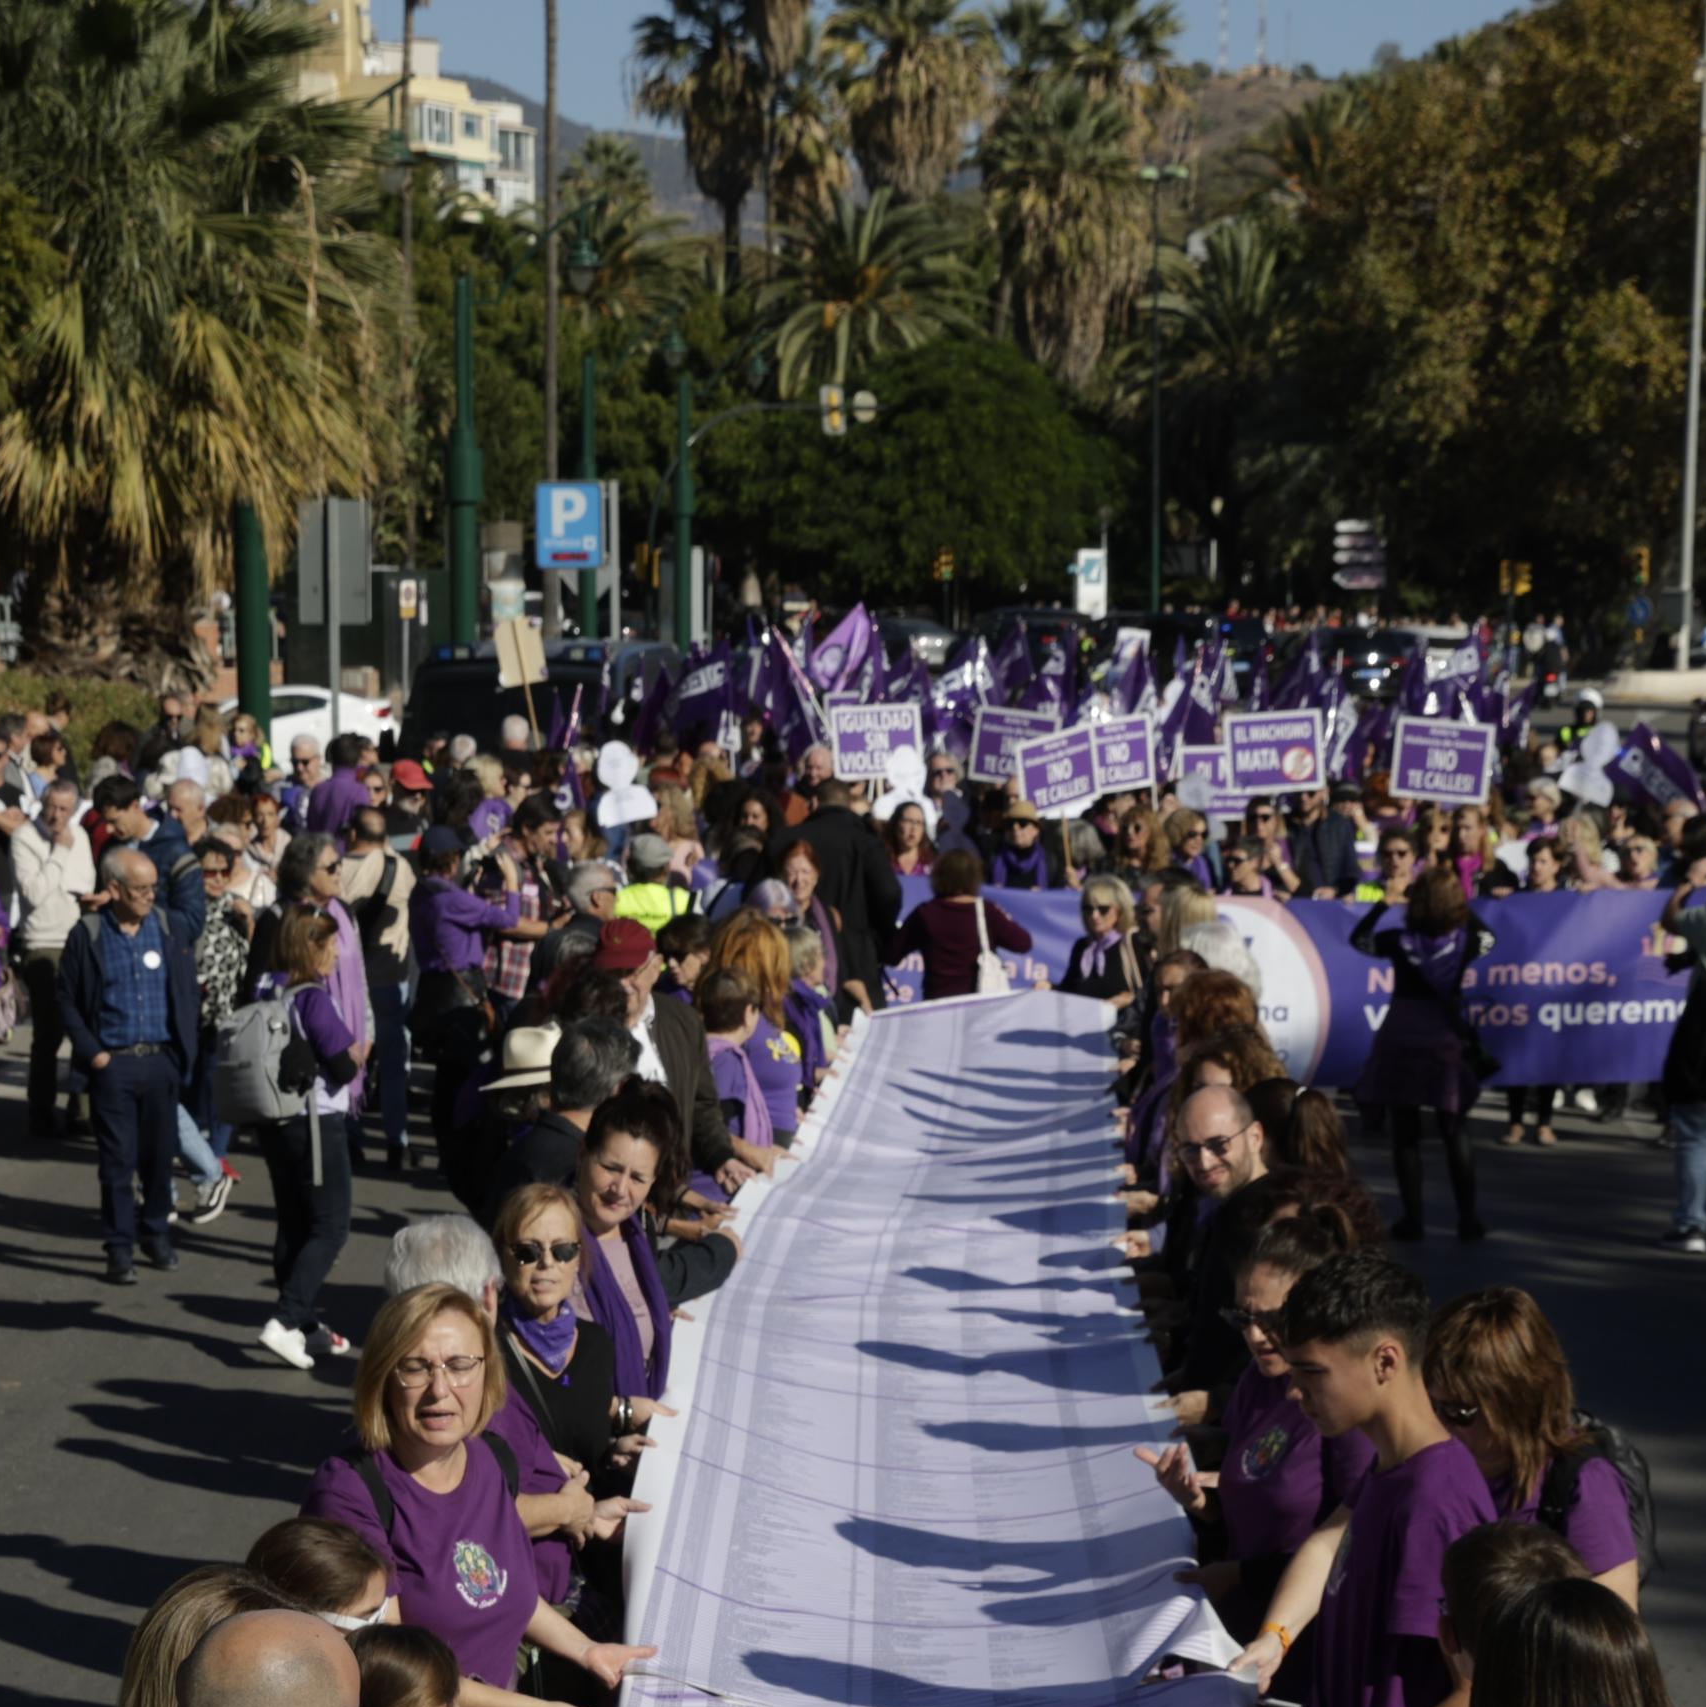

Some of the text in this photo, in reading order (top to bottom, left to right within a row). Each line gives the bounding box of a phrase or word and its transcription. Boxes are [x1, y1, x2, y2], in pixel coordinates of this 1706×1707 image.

[550, 487, 588, 538] P
[837, 708, 913, 735] IGUALDAD
[1233, 725, 1249, 744] EL
[864, 731, 890, 753] SIN
[1236, 747, 1281, 773] MATA
[1425, 746, 1460, 773] ¡NO
[1023, 956, 1049, 981] la
[1487, 960, 1618, 988] menos,
[1537, 997, 1687, 1033] querem
